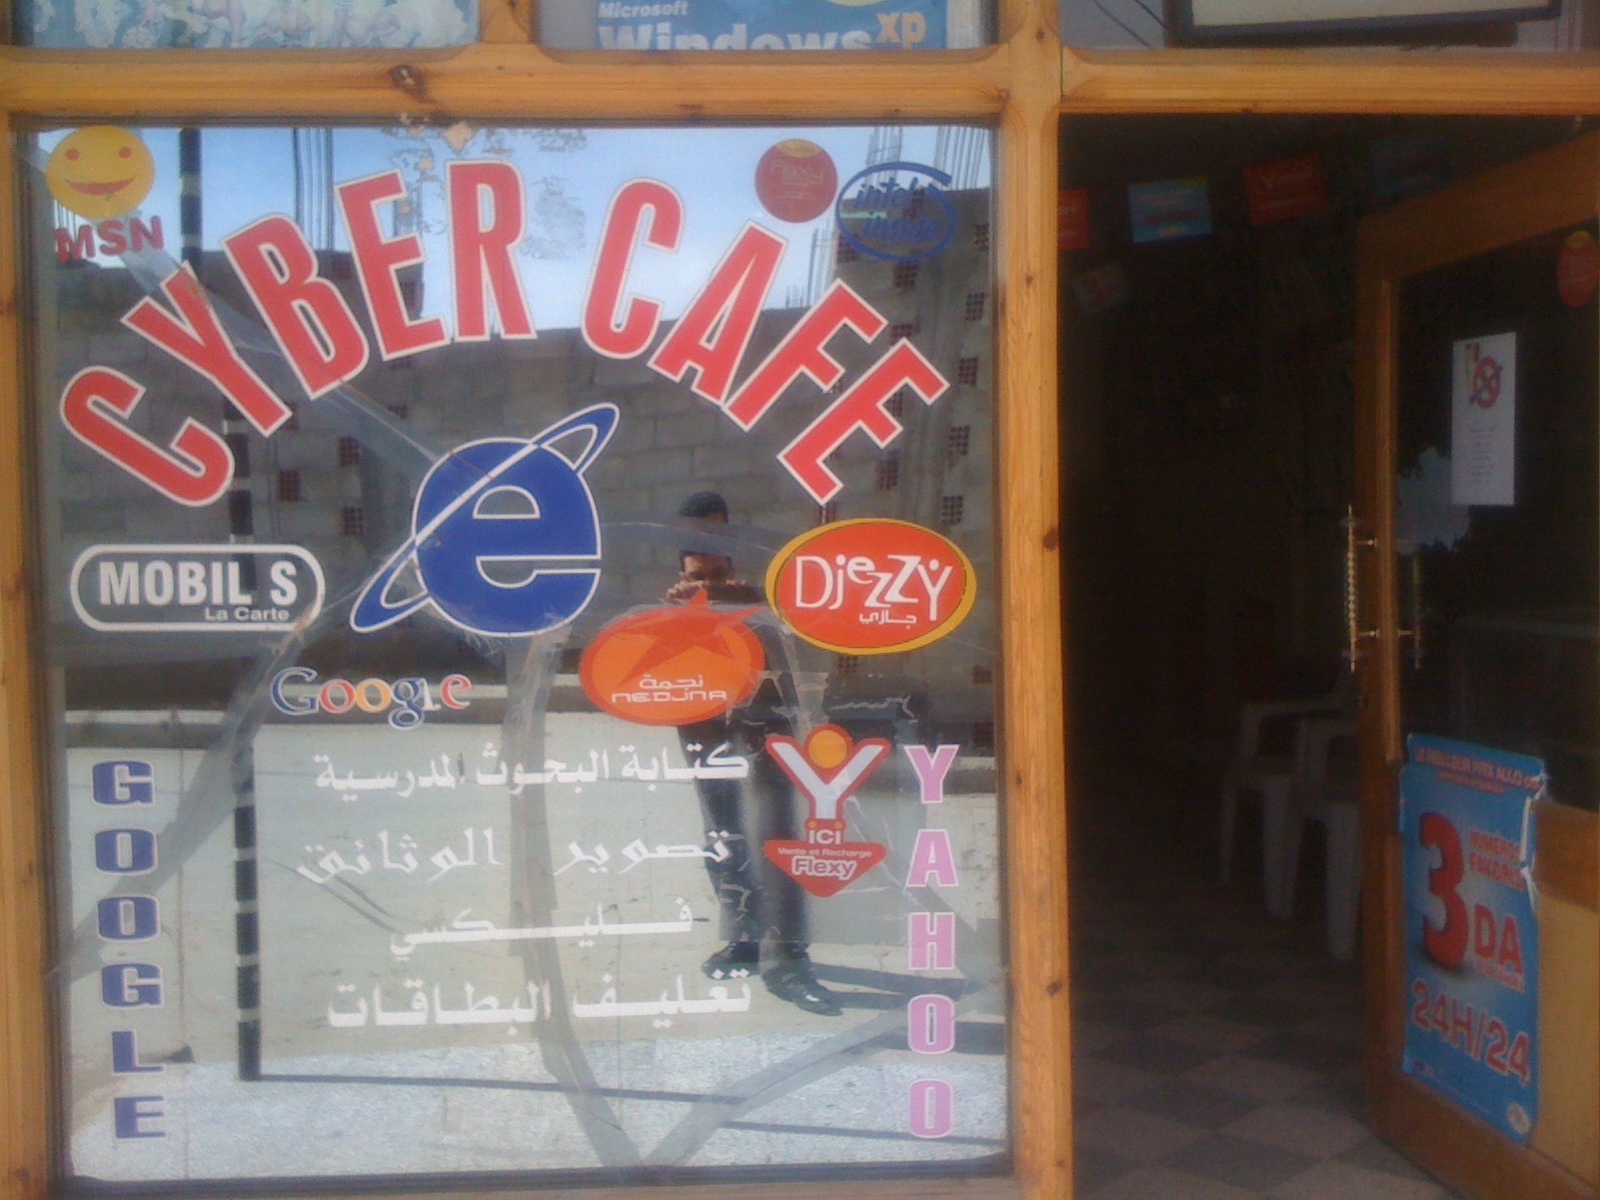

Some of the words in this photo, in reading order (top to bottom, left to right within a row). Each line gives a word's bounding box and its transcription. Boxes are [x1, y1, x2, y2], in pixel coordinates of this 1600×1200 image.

[597, 0, 689, 18] Microsoft
[598, 23, 872, 50] Windows
[54, 214, 165, 264] MSN
[59, 159, 539, 507] CYBER
[580, 177, 951, 507] CAFE
[99, 560, 252, 607] MOBIL
[270, 560, 298, 607] S
[204, 606, 231, 622] La
[237, 606, 290, 622] Carte
[270, 666, 472, 730] Google
[475, 741, 610, 796] البحوث
[621, 741, 750, 792] كتابة
[552, 830, 733, 877] تصوير
[778, 847, 807, 856] Vente
[809, 847, 821, 856] et
[822, 848, 873, 859] Recharge
[791, 855, 859, 881] Flexy
[1419, 811, 1470, 970] 3
[1474, 903, 1525, 976] DA
[91, 760, 168, 1140] GOOGLE
[904, 744, 960, 1139] YAHOO
[327, 978, 551, 1037] البطاقات
[1411, 977, 1531, 1088] 24H/24
